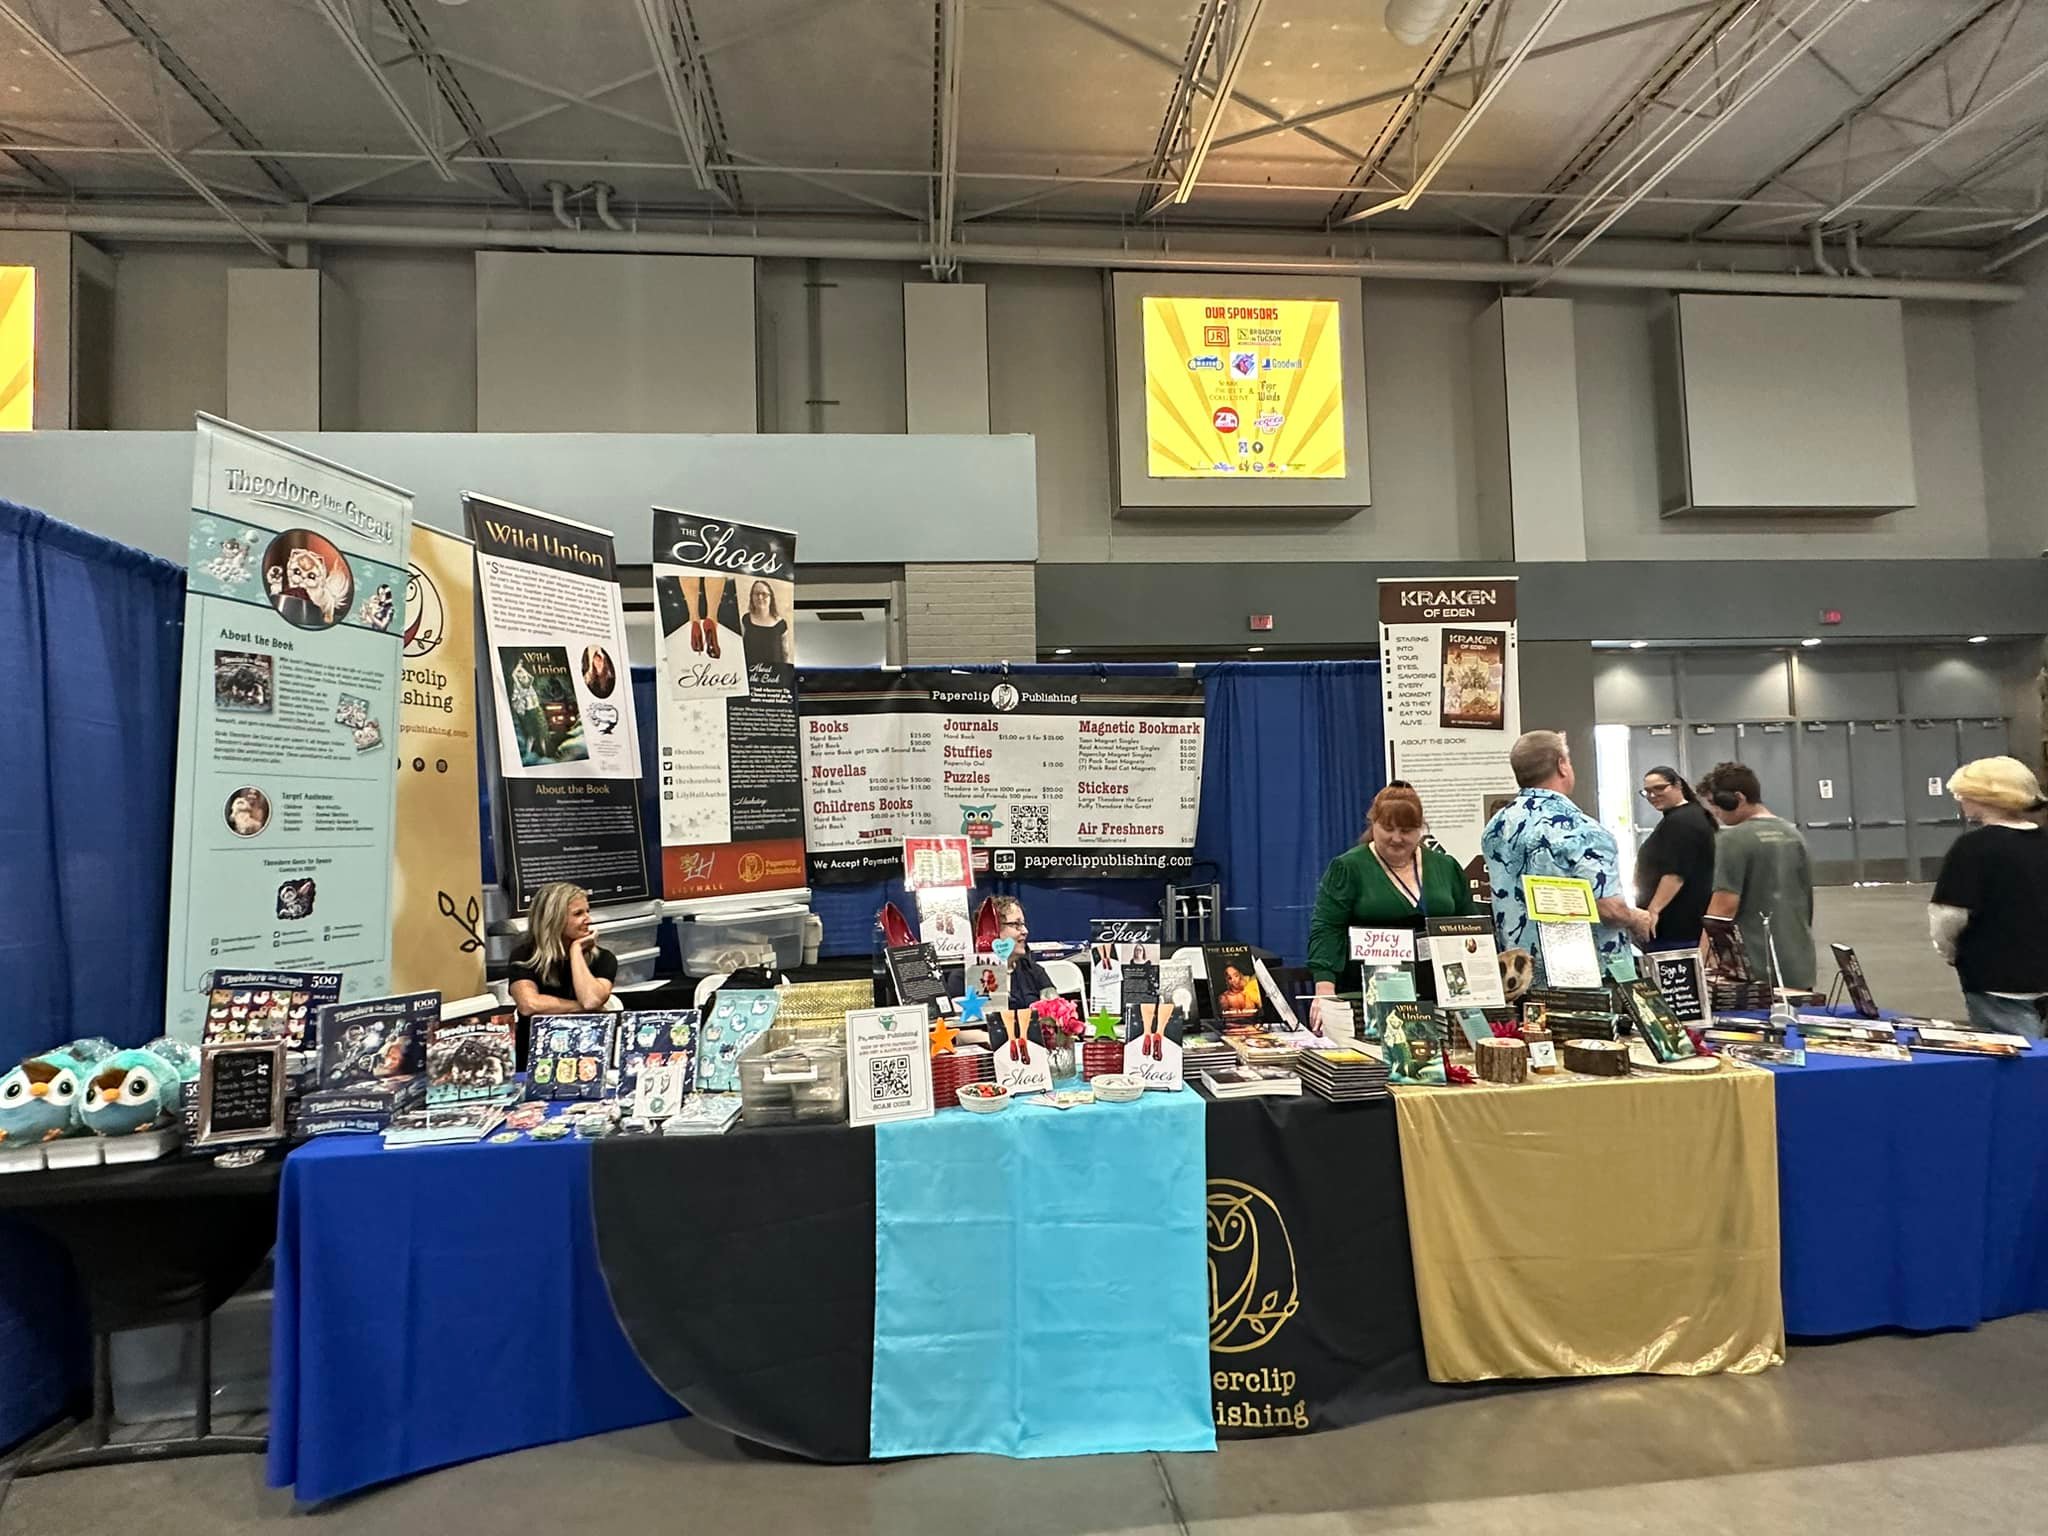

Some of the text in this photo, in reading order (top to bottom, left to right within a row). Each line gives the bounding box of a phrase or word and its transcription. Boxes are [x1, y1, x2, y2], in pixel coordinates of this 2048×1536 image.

[1205, 306, 1278, 320] OUR SPONSORS
[1272, 359, 1302, 369] Goodwill
[225, 468, 394, 545] Theodore the Great
[680, 527, 697, 537] THE
[485, 520, 604, 568] Wild Union
[672, 524, 783, 574] Shoes
[1401, 589, 1497, 606] KRAKEN
[1424, 608, 1475, 618] OF EDEN
[220, 628, 294, 651] About the Book
[1449, 634, 1498, 645] KRAKEN
[532, 662, 568, 675] Union
[678, 663, 741, 689] Shoes
[1398, 672, 1437, 680] SAVORING
[932, 690, 1078, 705] Paperclip Publishing
[809, 720, 849, 733] Books
[943, 718, 999, 732] Journals
[1079, 720, 1200, 736] Magnetic Bookmark
[943, 745, 993, 759] Stuffies
[811, 764, 867, 778] Novellas
[943, 760, 971, 768] Paperclip
[943, 770, 991, 784] Puzzles
[535, 783, 611, 794] About the Book
[1078, 781, 1129, 794] Stickers
[813, 797, 913, 815] Childrens Books
[1077, 822, 1165, 836] Air Freshners
[814, 860, 828, 870] We
[830, 858, 860, 870] Accept
[863, 856, 899, 868] Payments
[1024, 852, 1193, 869] paperclippublishing.com
[1100, 922, 1152, 943] Shoes
[1364, 930, 1400, 950] Spicy
[1354, 944, 1412, 959] Romance
[1660, 965, 1677, 979] Sign
[311, 975, 338, 988] 500
[334, 998, 437, 1023] Theodore Great 1000
[1402, 1012, 1432, 1021] Union
[435, 1023, 511, 1040] Theodore Great
[1002, 1068, 1046, 1087] Shoes
[1129, 1063, 1177, 1082] Shoes
[1213, 1367, 1296, 1396] erclip
[1216, 1400, 1309, 1429] ishing
